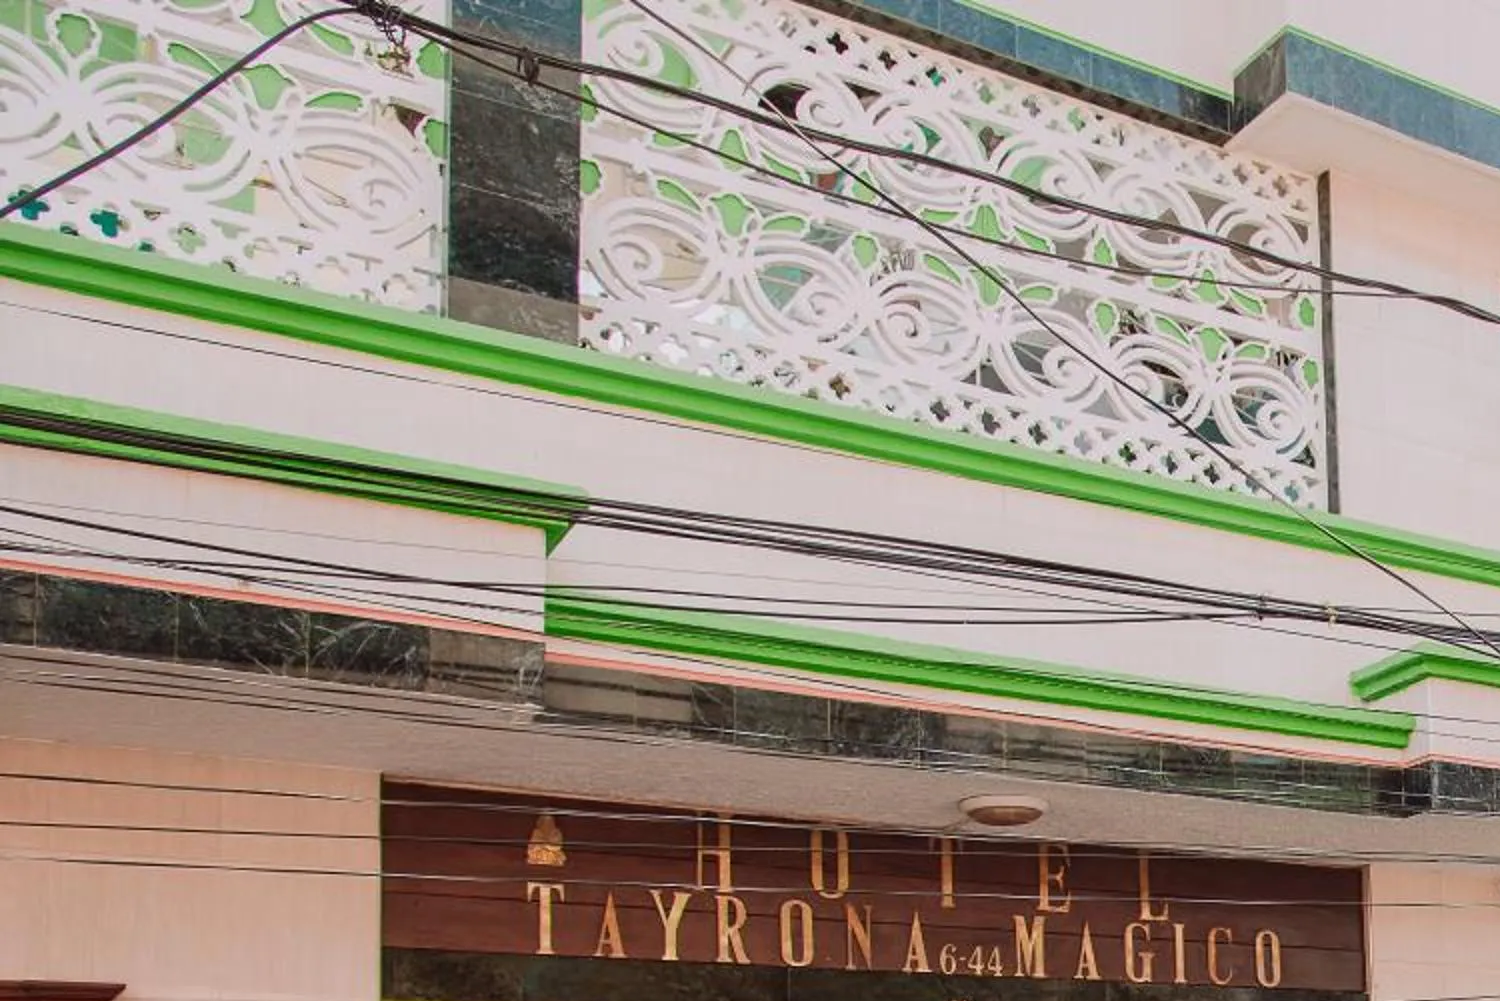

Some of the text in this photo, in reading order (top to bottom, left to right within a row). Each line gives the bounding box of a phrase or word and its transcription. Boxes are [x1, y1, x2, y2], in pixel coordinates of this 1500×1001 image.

[697, 812, 1169, 921] HOTEL
[527, 881, 1281, 989] TAYRONA MAGICO
[939, 944, 1003, 976] 6-44
